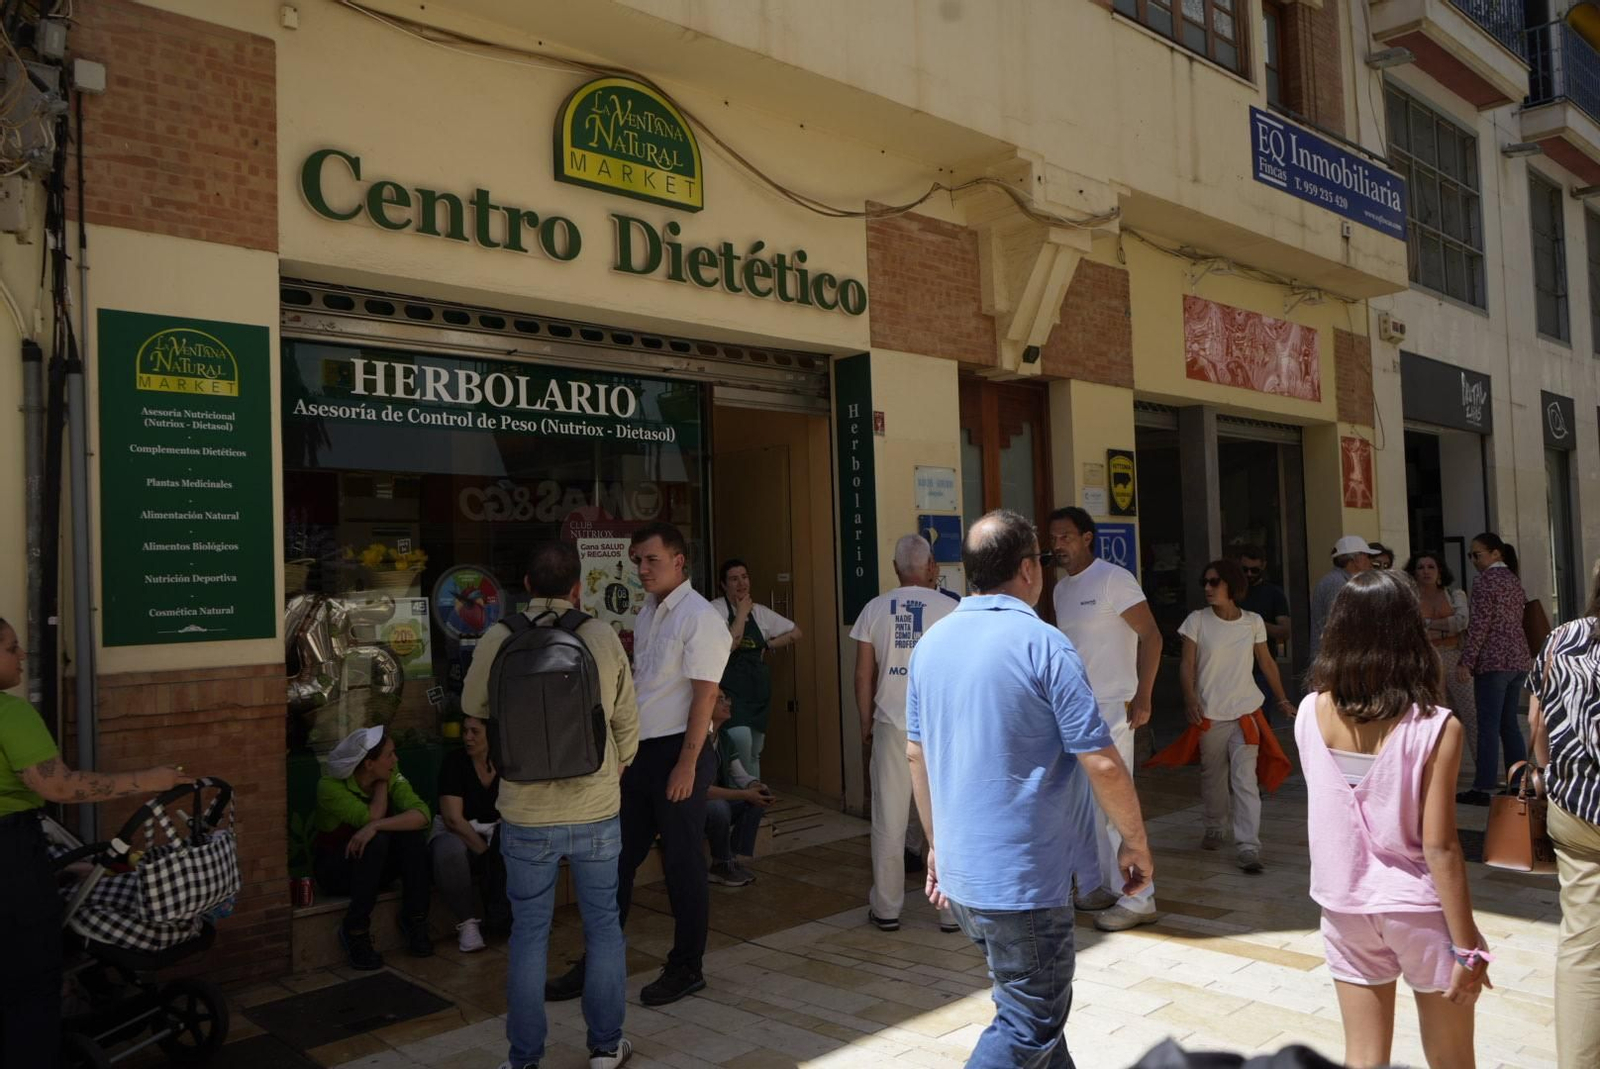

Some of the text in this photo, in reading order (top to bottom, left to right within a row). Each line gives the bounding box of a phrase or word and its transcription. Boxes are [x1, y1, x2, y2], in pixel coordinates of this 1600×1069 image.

[1257, 121, 1402, 213] EQ Inmobiliaria
[1259, 156, 1287, 182] Fincas
[570, 151, 696, 198] MARKET
[1303, 182, 1318, 197] 959
[1320, 187, 1333, 203] 235
[301, 148, 867, 316] Centro Dietético
[139, 375, 235, 394] MARKET
[350, 357, 636, 418] HERBOLARIO
[184, 409, 236, 421] Nutricional
[293, 398, 376, 421] Asesoría
[381, 404, 403, 423] de
[407, 407, 473, 427] Control
[477, 413, 496, 429] de
[500, 415, 537, 432] Peso
[541, 417, 604, 437] (Nutriox
[616, 424, 676, 442] Dietasol)
[144, 418, 186, 428] (Nutriox
[192, 421, 234, 432] Dietasol)
[129, 444, 247, 457] Complementos Dietéticos
[146, 478, 233, 489] Plantas Medicinales
[140, 510, 240, 520] Alimentación Natural
[570, 530, 614, 539] NUTRIOX
[142, 542, 239, 552] Alimentos Biológicos
[1100, 536, 1127, 566] EQ
[144, 573, 238, 585] Nutrición Deportiva
[149, 605, 234, 617] Cosmética Natural
[895, 615, 912, 623] NADIE
[895, 632, 911, 640] COMO
[895, 640, 919, 649] PROFES
[889, 666, 908, 676] MO
